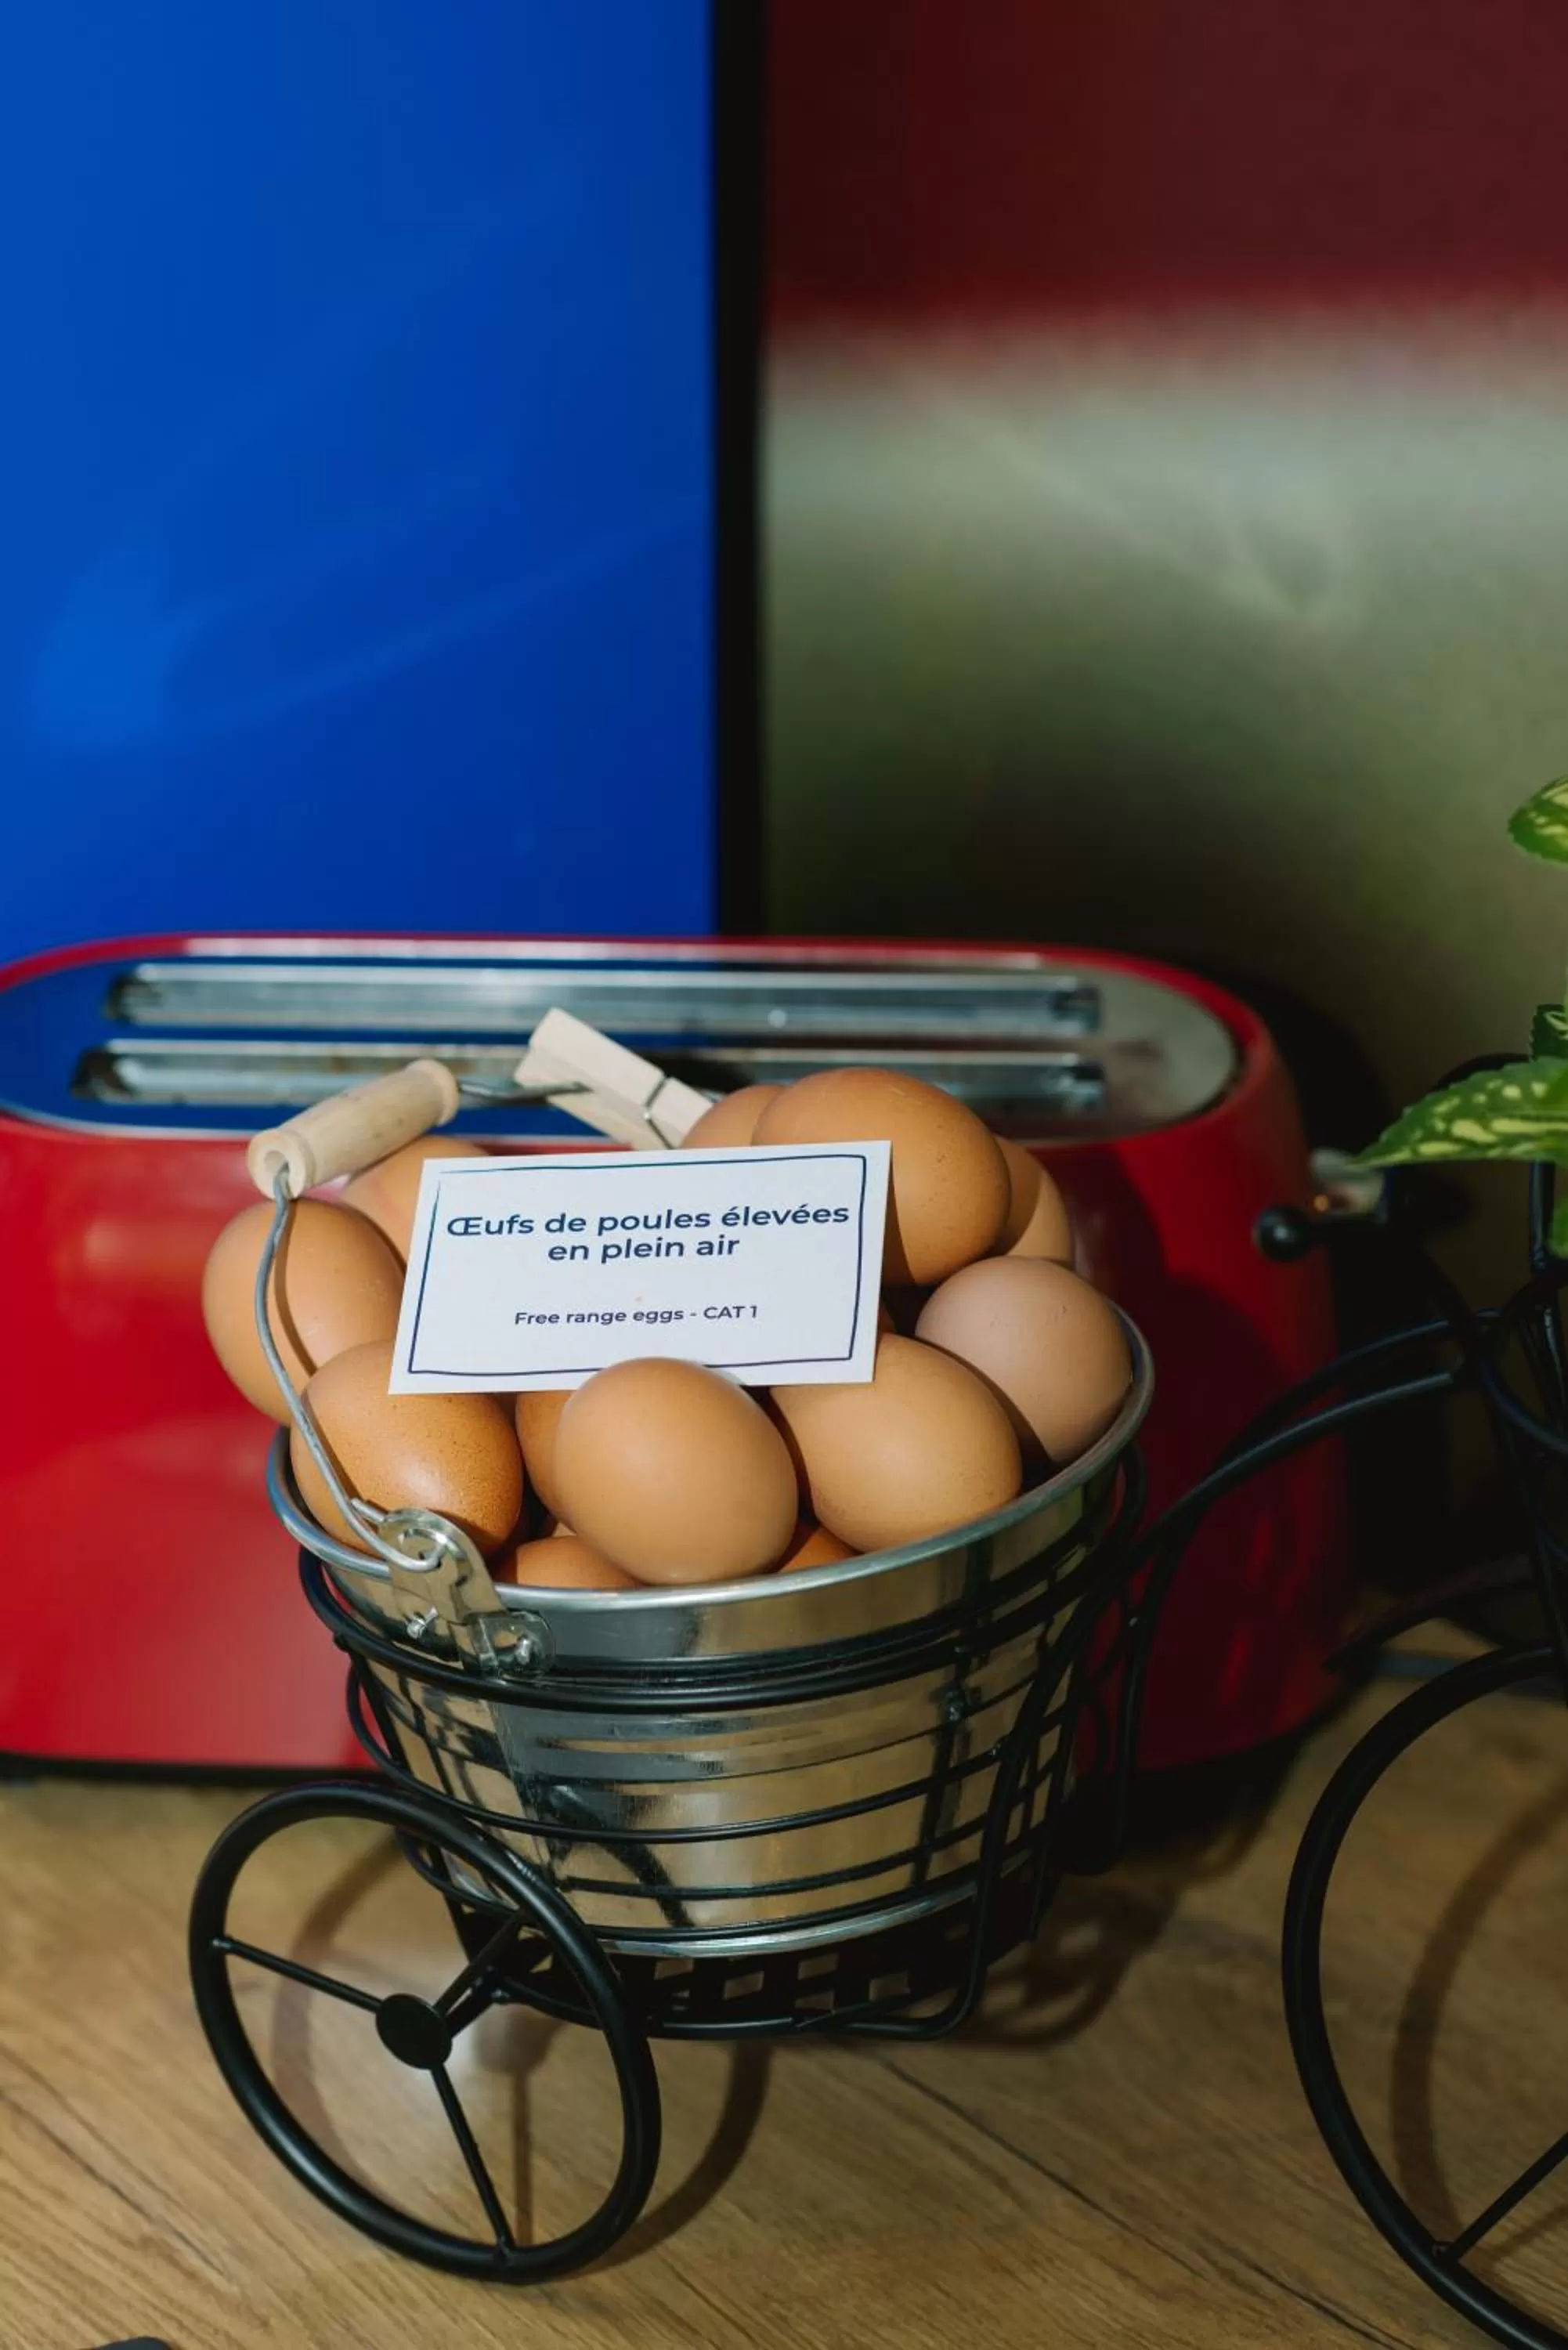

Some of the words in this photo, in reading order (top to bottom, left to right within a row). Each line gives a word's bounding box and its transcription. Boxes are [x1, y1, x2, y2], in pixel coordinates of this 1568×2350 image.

[446, 1213, 535, 1237] Œufs
[544, 1212, 587, 1234] de
[597, 1209, 711, 1237] poules
[721, 1203, 850, 1227] élevées
[547, 1245, 590, 1261] en
[601, 1236, 685, 1264] plein
[695, 1234, 740, 1256] air
[514, 1311, 560, 1325] Free
[566, 1312, 627, 1325] range
[632, 1310, 685, 1325] eggs
[703, 1306, 746, 1320] CAT
[750, 1305, 757, 1318] 1
